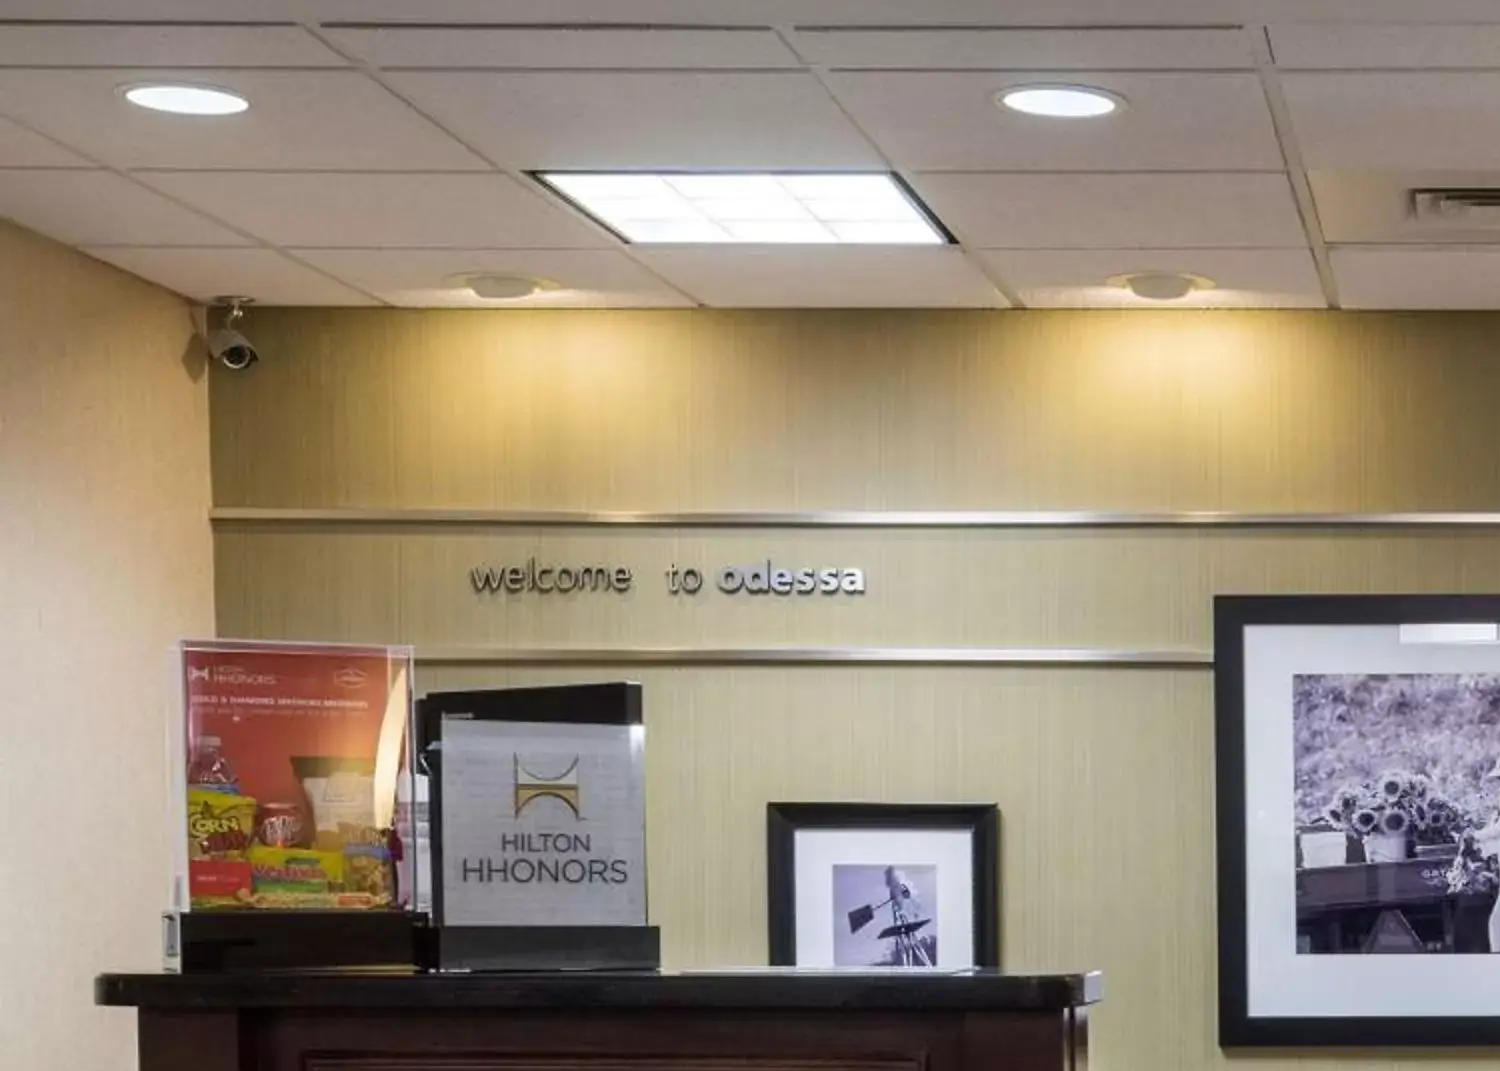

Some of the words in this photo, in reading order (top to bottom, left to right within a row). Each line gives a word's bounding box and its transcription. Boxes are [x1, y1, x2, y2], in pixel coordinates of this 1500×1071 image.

[471, 557, 632, 595] welcome
[666, 563, 703, 594] to
[718, 560, 867, 596] odessa
[188, 814, 241, 840] CORN
[501, 833, 592, 853] HILTON
[462, 858, 629, 884] HHONORS
